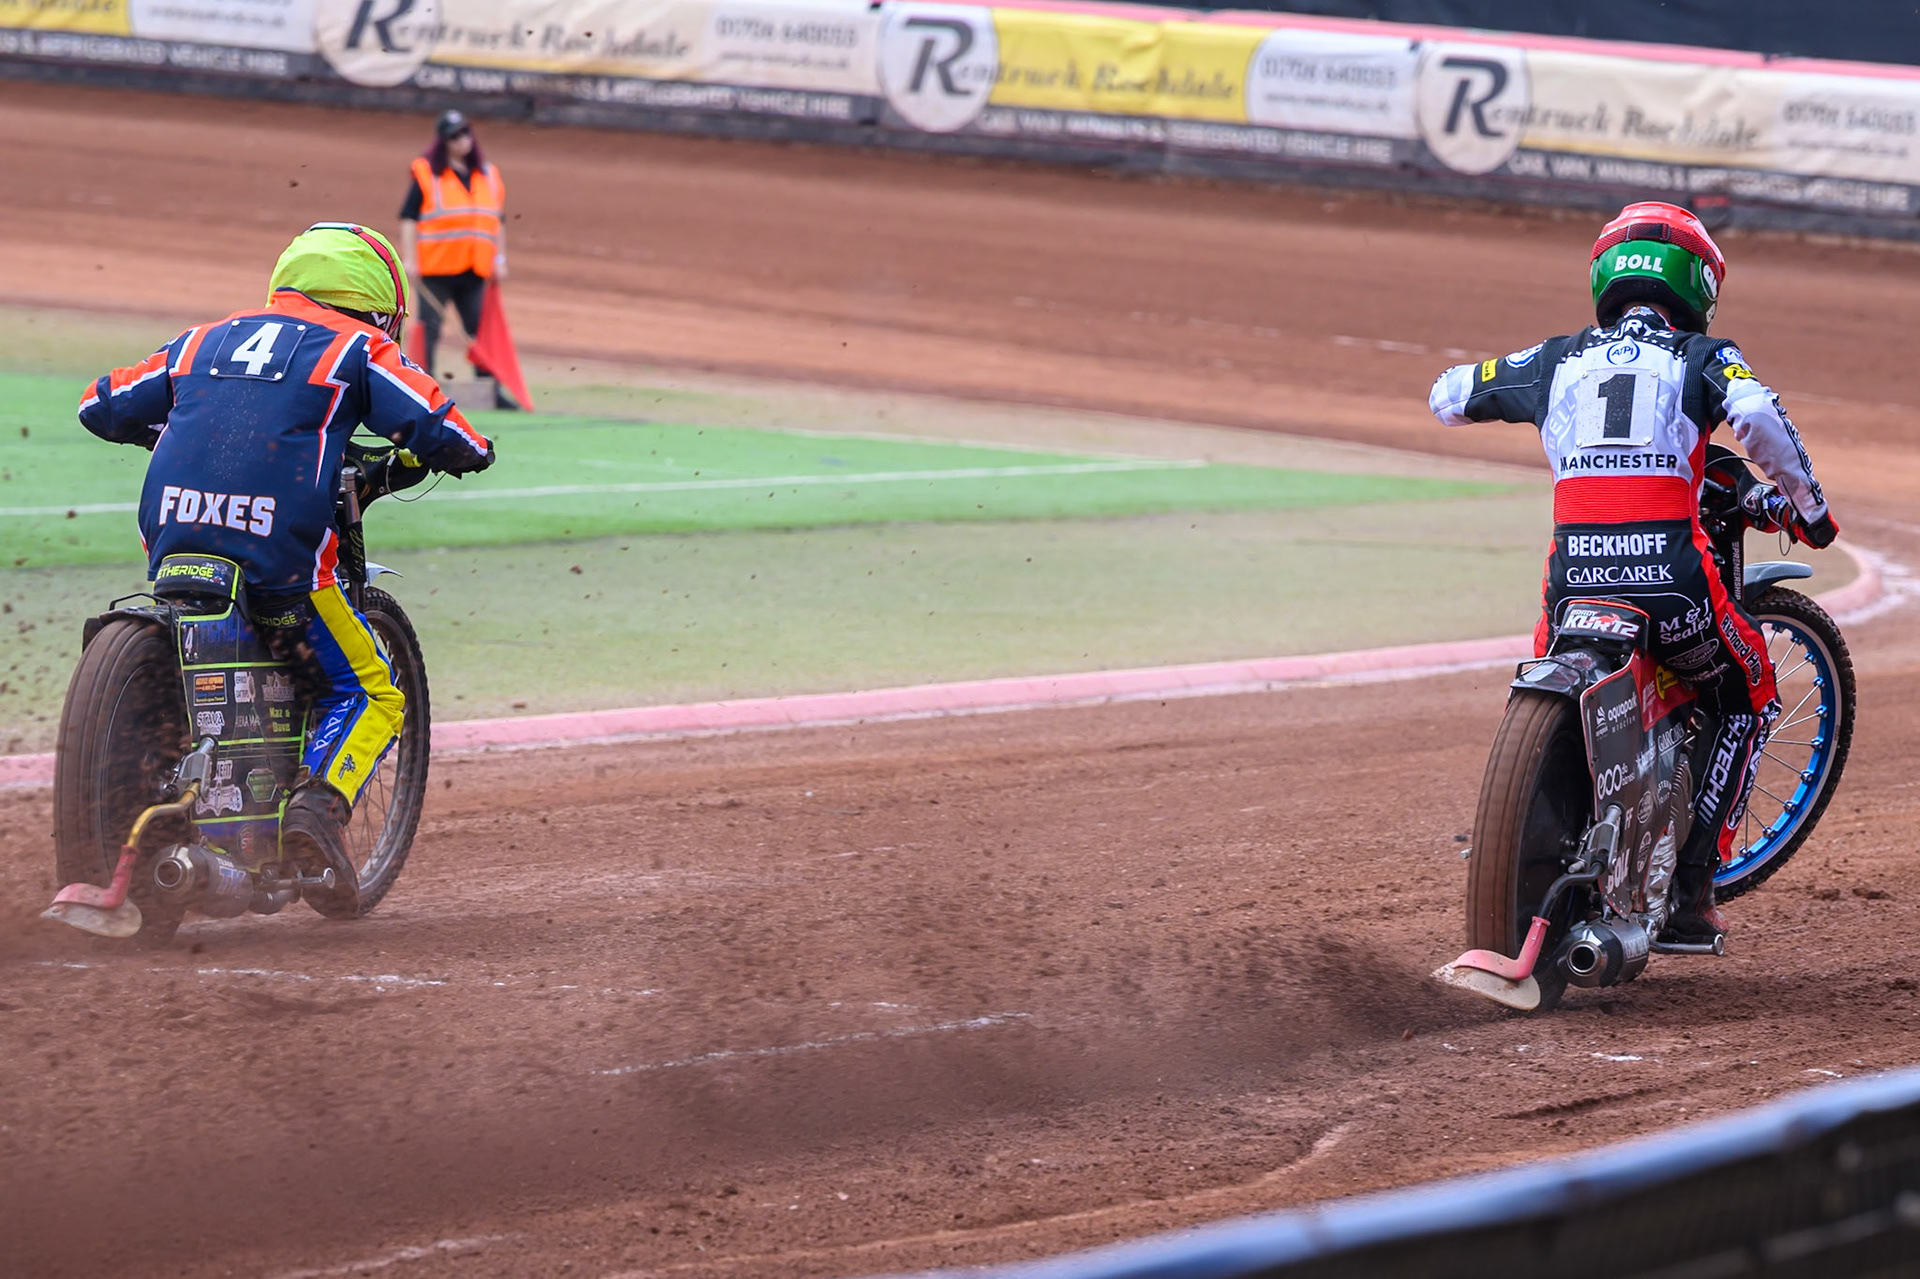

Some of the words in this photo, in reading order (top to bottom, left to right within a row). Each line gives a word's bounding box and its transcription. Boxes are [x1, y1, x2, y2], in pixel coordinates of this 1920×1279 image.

[1614, 254, 1663, 273] BOLL
[230, 322, 283, 375] 4
[1598, 374, 1637, 438] 1
[1560, 453, 1678, 472] MANCHESTER
[158, 485, 277, 537] FOXES
[1568, 533, 1668, 557] BECKHOFF
[1566, 564, 1674, 584] GARCAREK
[1732, 546, 1742, 601] PREMIERSHIP
[1563, 614, 1641, 638] KURTZ
[1659, 616, 1680, 633] M
[1685, 607, 1701, 624] &
[1702, 597, 1709, 617] J
[1660, 612, 1712, 644] Sealey
[183, 626, 194, 651] 4
[1720, 613, 1752, 658] Richard
